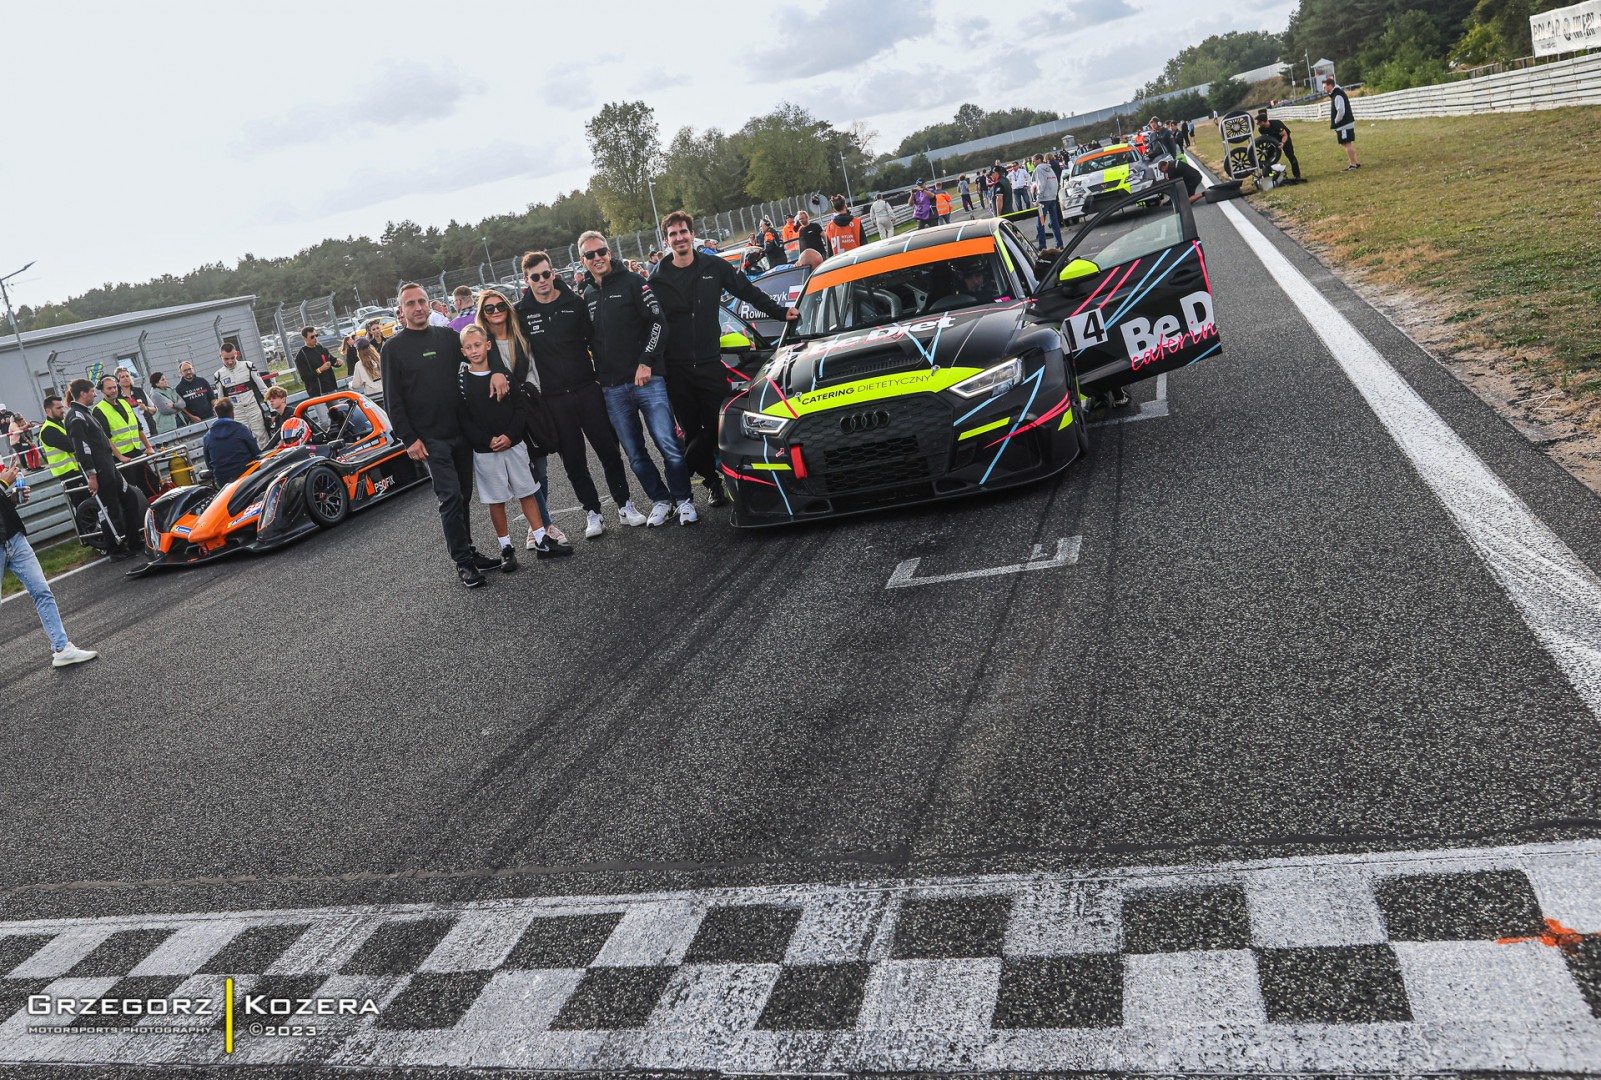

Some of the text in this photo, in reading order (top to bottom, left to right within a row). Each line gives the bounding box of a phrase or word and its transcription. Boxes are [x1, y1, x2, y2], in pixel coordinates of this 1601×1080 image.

[866, 316, 956, 342] Diet
[1064, 310, 1105, 351] 14
[1120, 314, 1184, 362] Be
[802, 375, 931, 405] CATERING DIETETYCZNY
